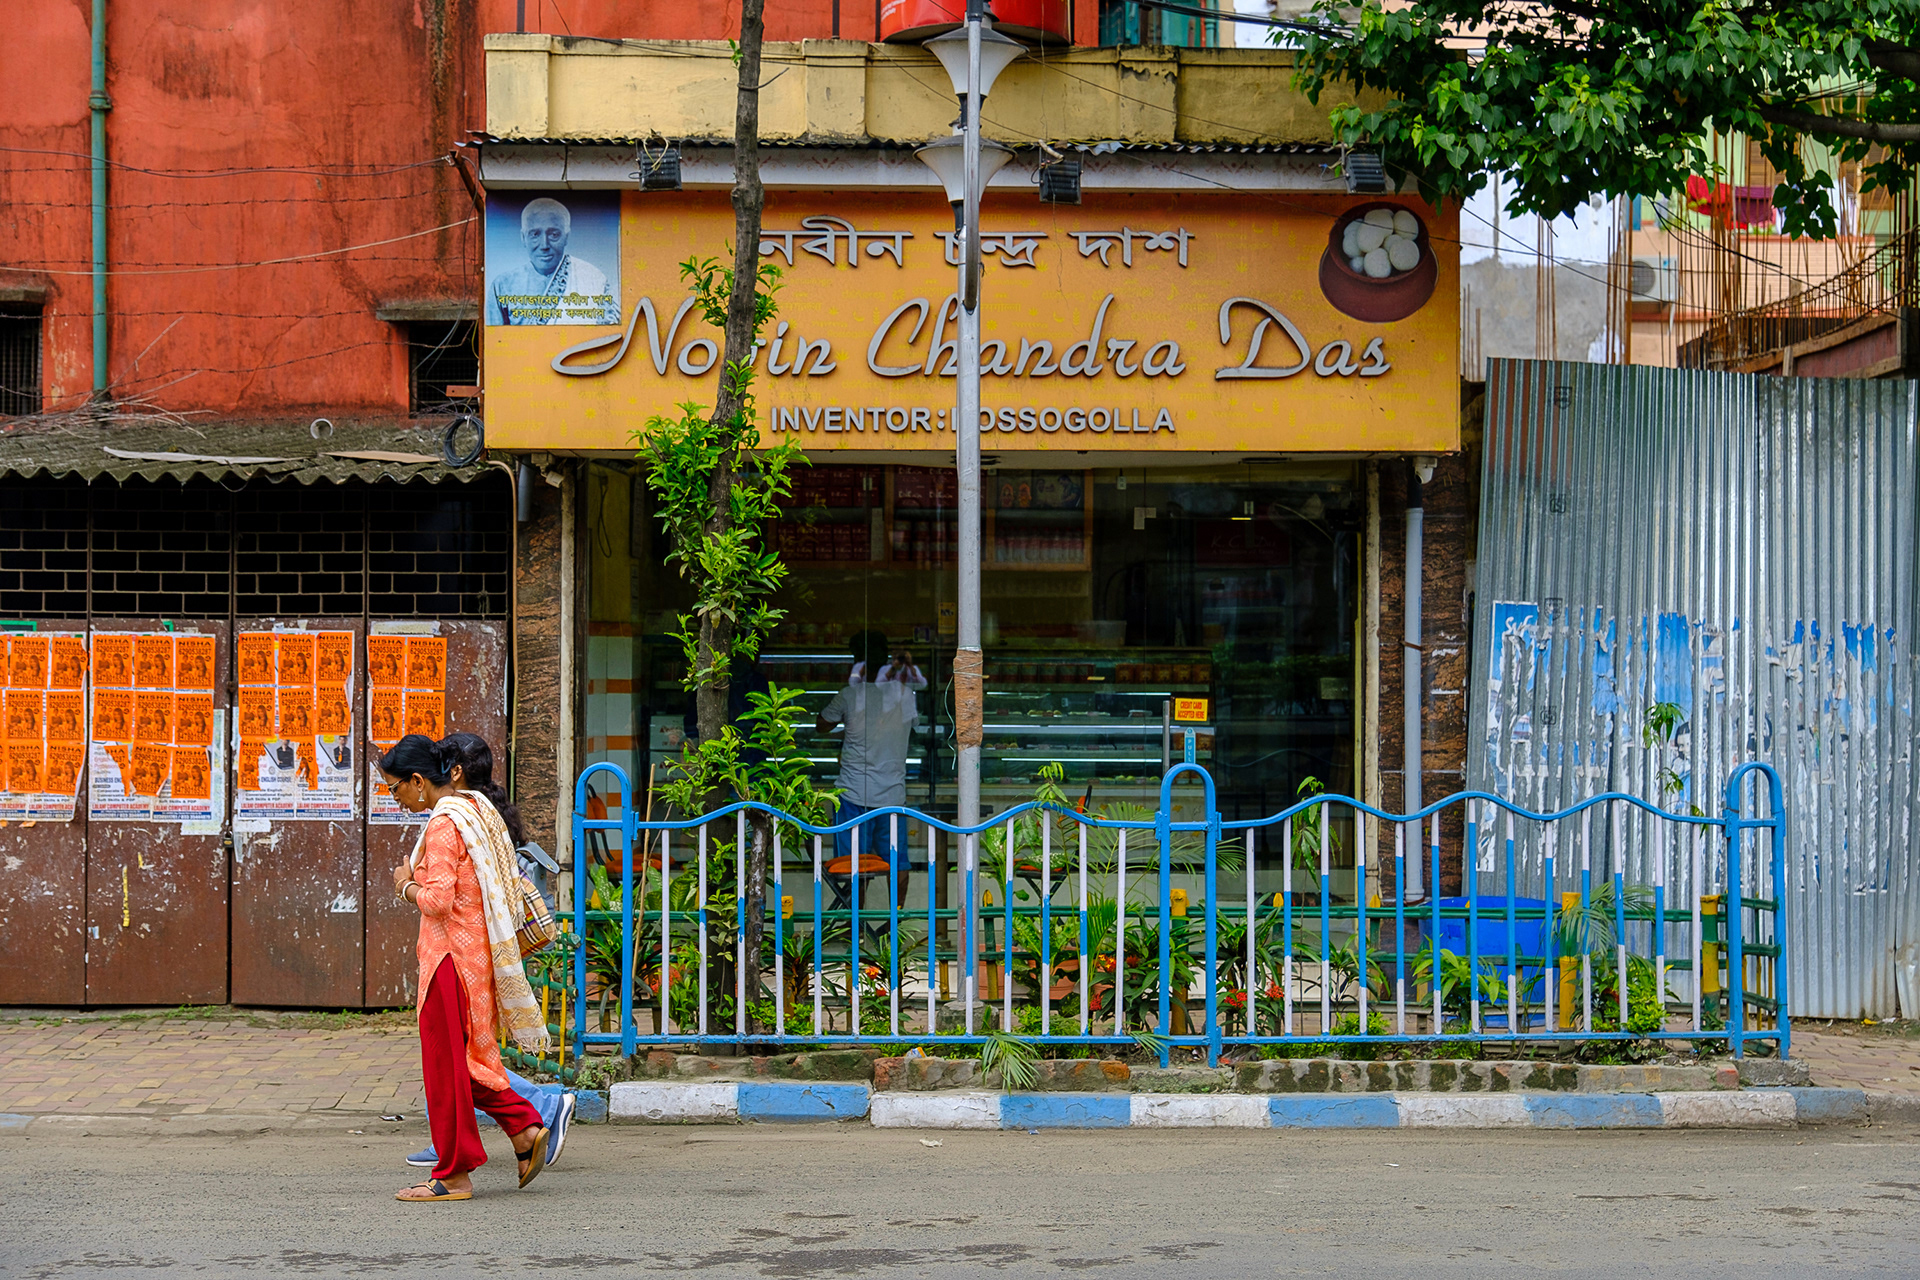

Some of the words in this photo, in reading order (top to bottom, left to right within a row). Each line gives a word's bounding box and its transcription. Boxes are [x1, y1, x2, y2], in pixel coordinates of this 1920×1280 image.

[758, 215, 914, 267] নবীন
[1067, 226, 1195, 268] দাশ
[563, 292, 590, 305] নবীন
[551, 295, 837, 376] Noin
[867, 293, 1186, 378] Chandra
[1215, 296, 1392, 381] Das
